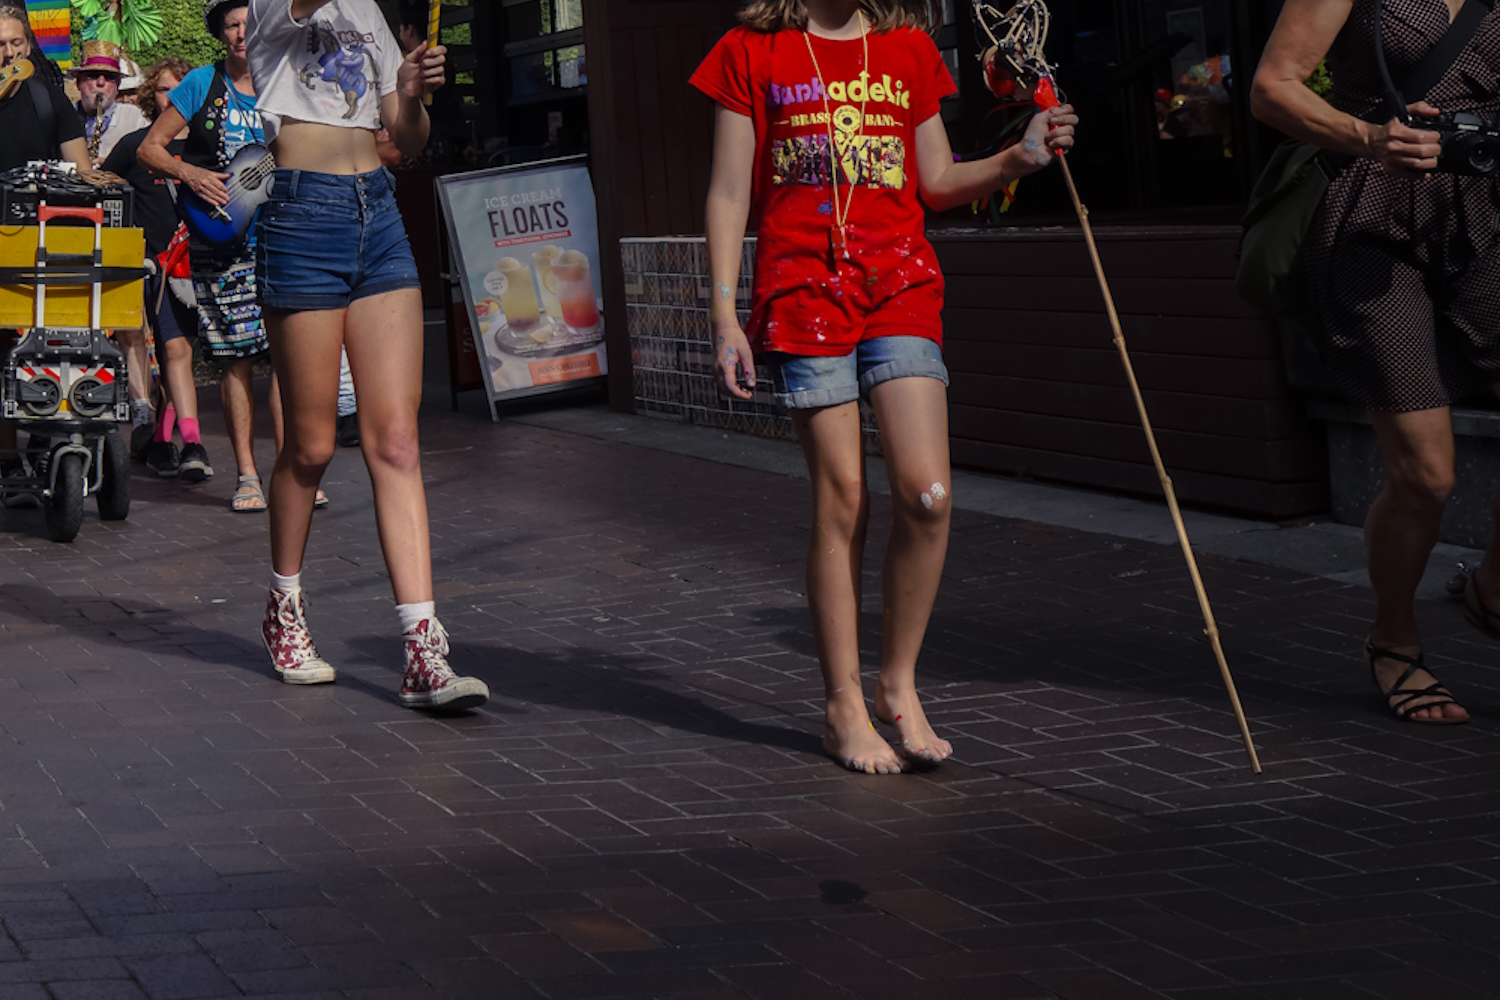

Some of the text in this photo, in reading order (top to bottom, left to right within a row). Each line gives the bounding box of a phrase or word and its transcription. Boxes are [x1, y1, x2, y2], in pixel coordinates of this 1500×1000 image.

[790, 112, 831, 127] BRASS
[484, 188, 563, 209] ICE CREAM
[487, 201, 569, 238] FLOATS
